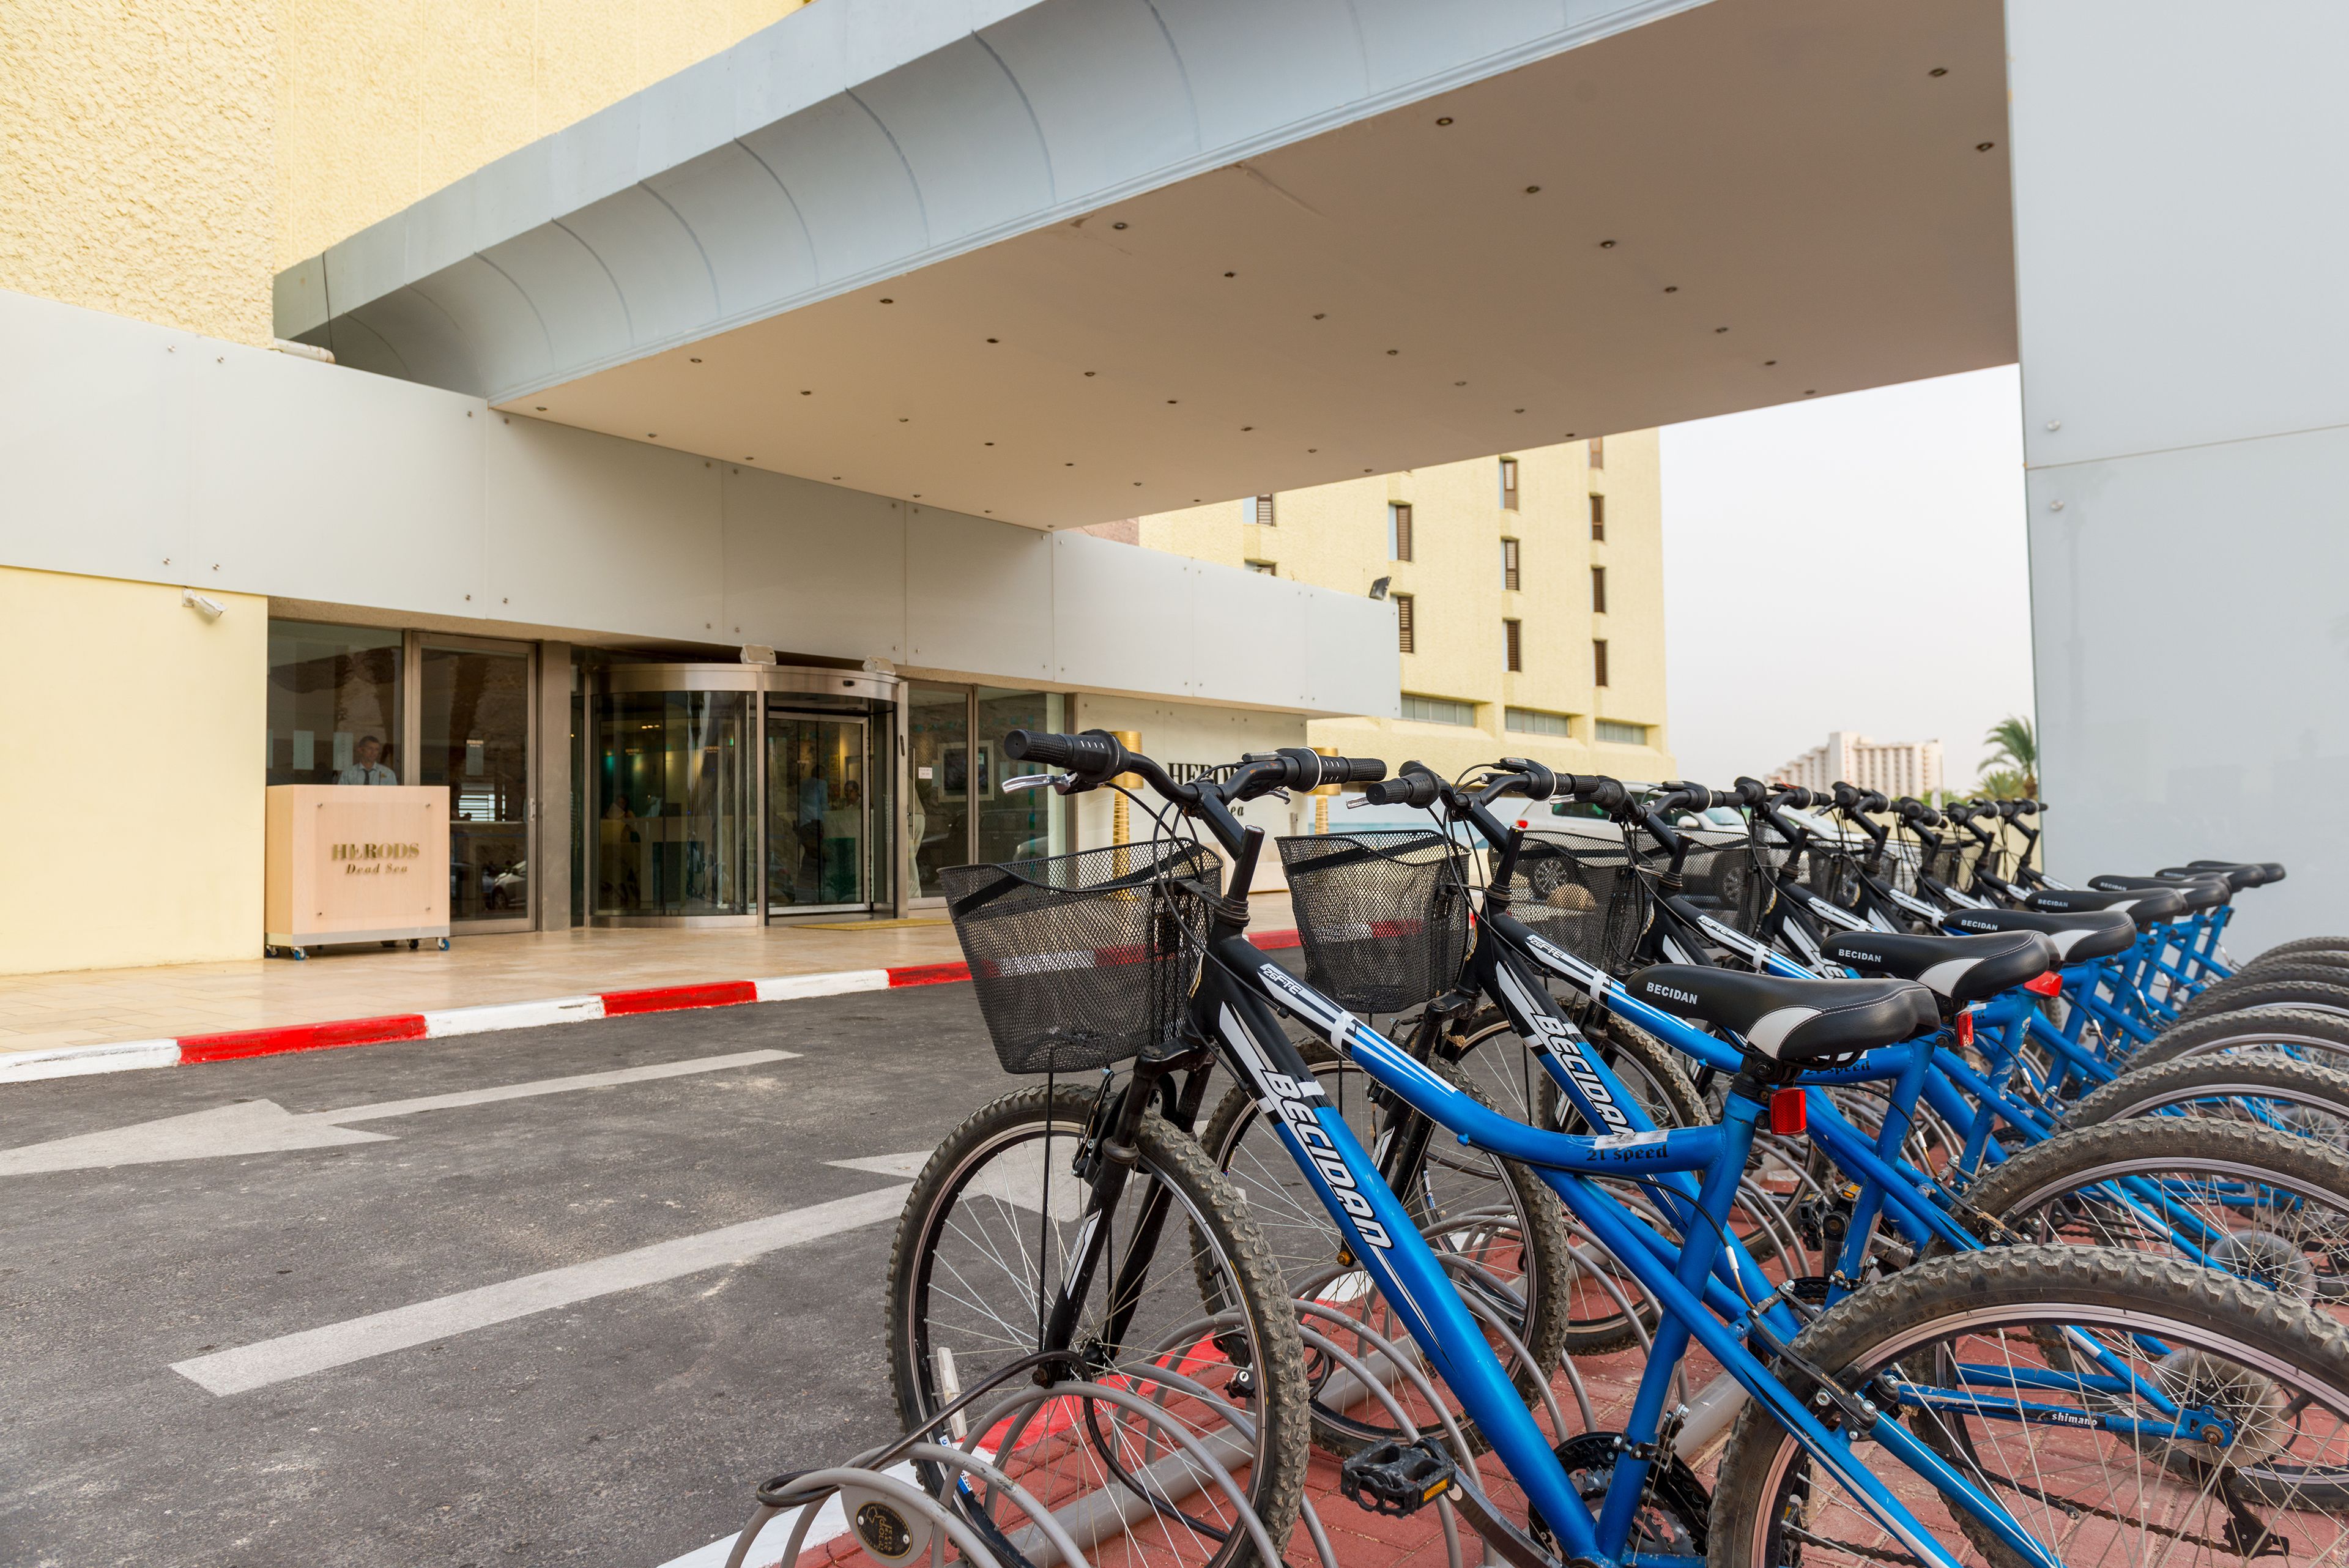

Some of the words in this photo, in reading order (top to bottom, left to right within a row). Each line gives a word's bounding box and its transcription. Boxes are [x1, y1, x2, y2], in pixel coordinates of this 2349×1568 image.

[1167, 763, 1237, 786] HERO
[1230, 805, 1244, 816] ea
[332, 842, 420, 860] HERODS
[346, 863, 380, 874] Dead
[385, 863, 408, 873] Sea
[2037, 898, 2069, 907] BECIDAN
[1961, 919, 1998, 931] BECIDAN
[1838, 948, 1881, 963] BECIDAN
[1646, 981, 1698, 1005] BECIDAN
[1613, 1143, 1669, 1162] speed
[2052, 1411, 2098, 1427] shimano
